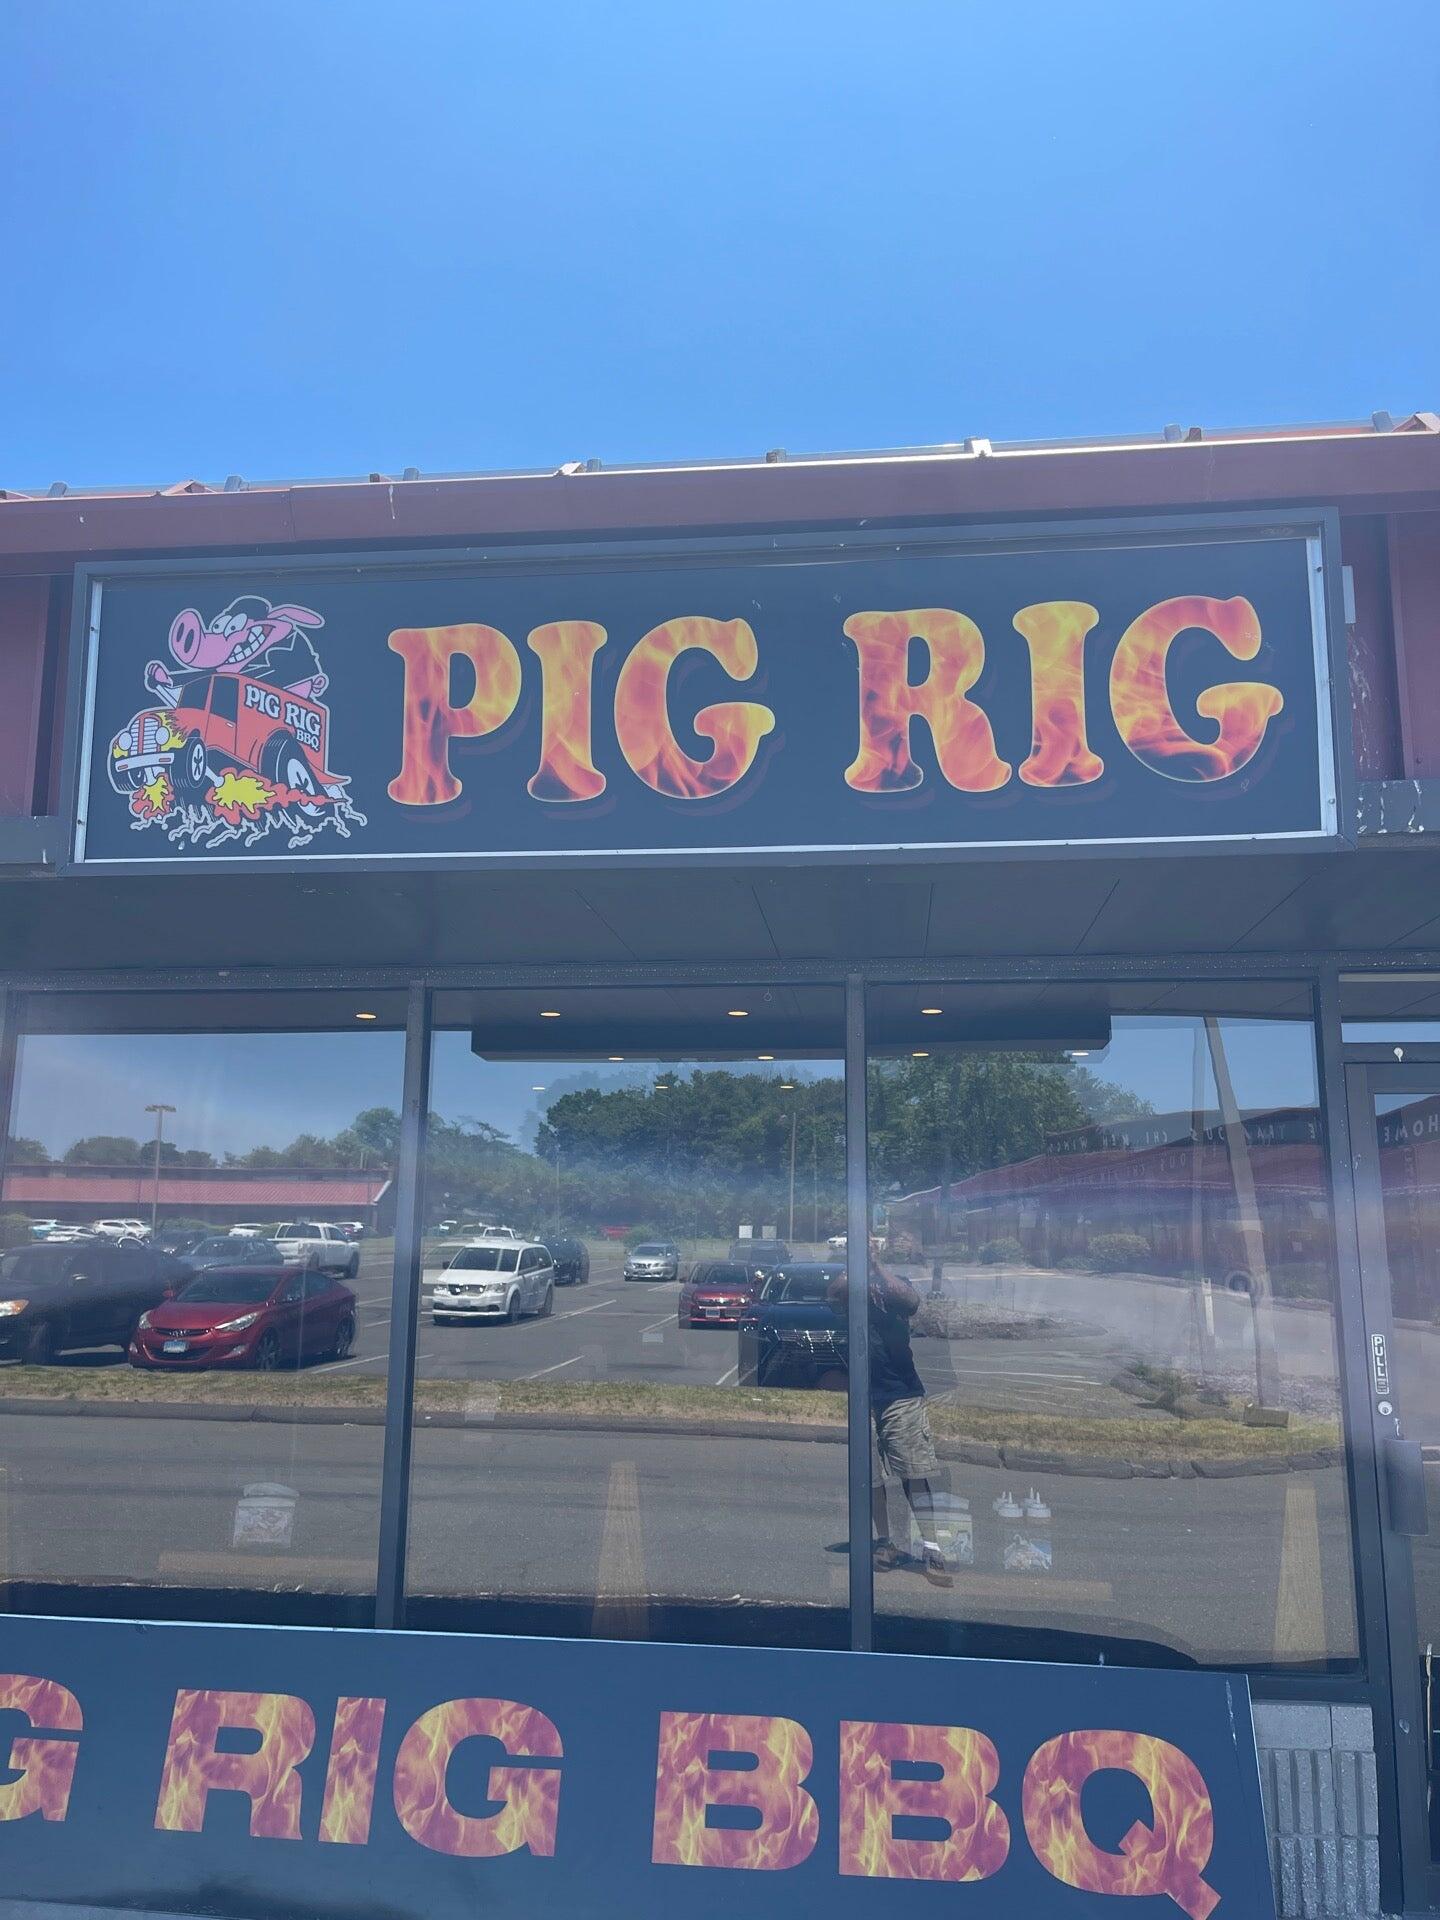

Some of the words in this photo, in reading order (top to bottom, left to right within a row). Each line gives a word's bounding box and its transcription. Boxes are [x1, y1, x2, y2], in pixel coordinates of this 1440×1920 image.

[246, 685, 280, 718] PIG
[286, 702, 321, 736] RIG
[387, 615, 776, 806] PIG
[843, 594, 1285, 793] RIG
[296, 729, 320, 751] BBQ
[1373, 1336, 1385, 1377] PULL
[153, 1688, 565, 1859] RIG
[651, 1710, 1222, 1920] BBQ
